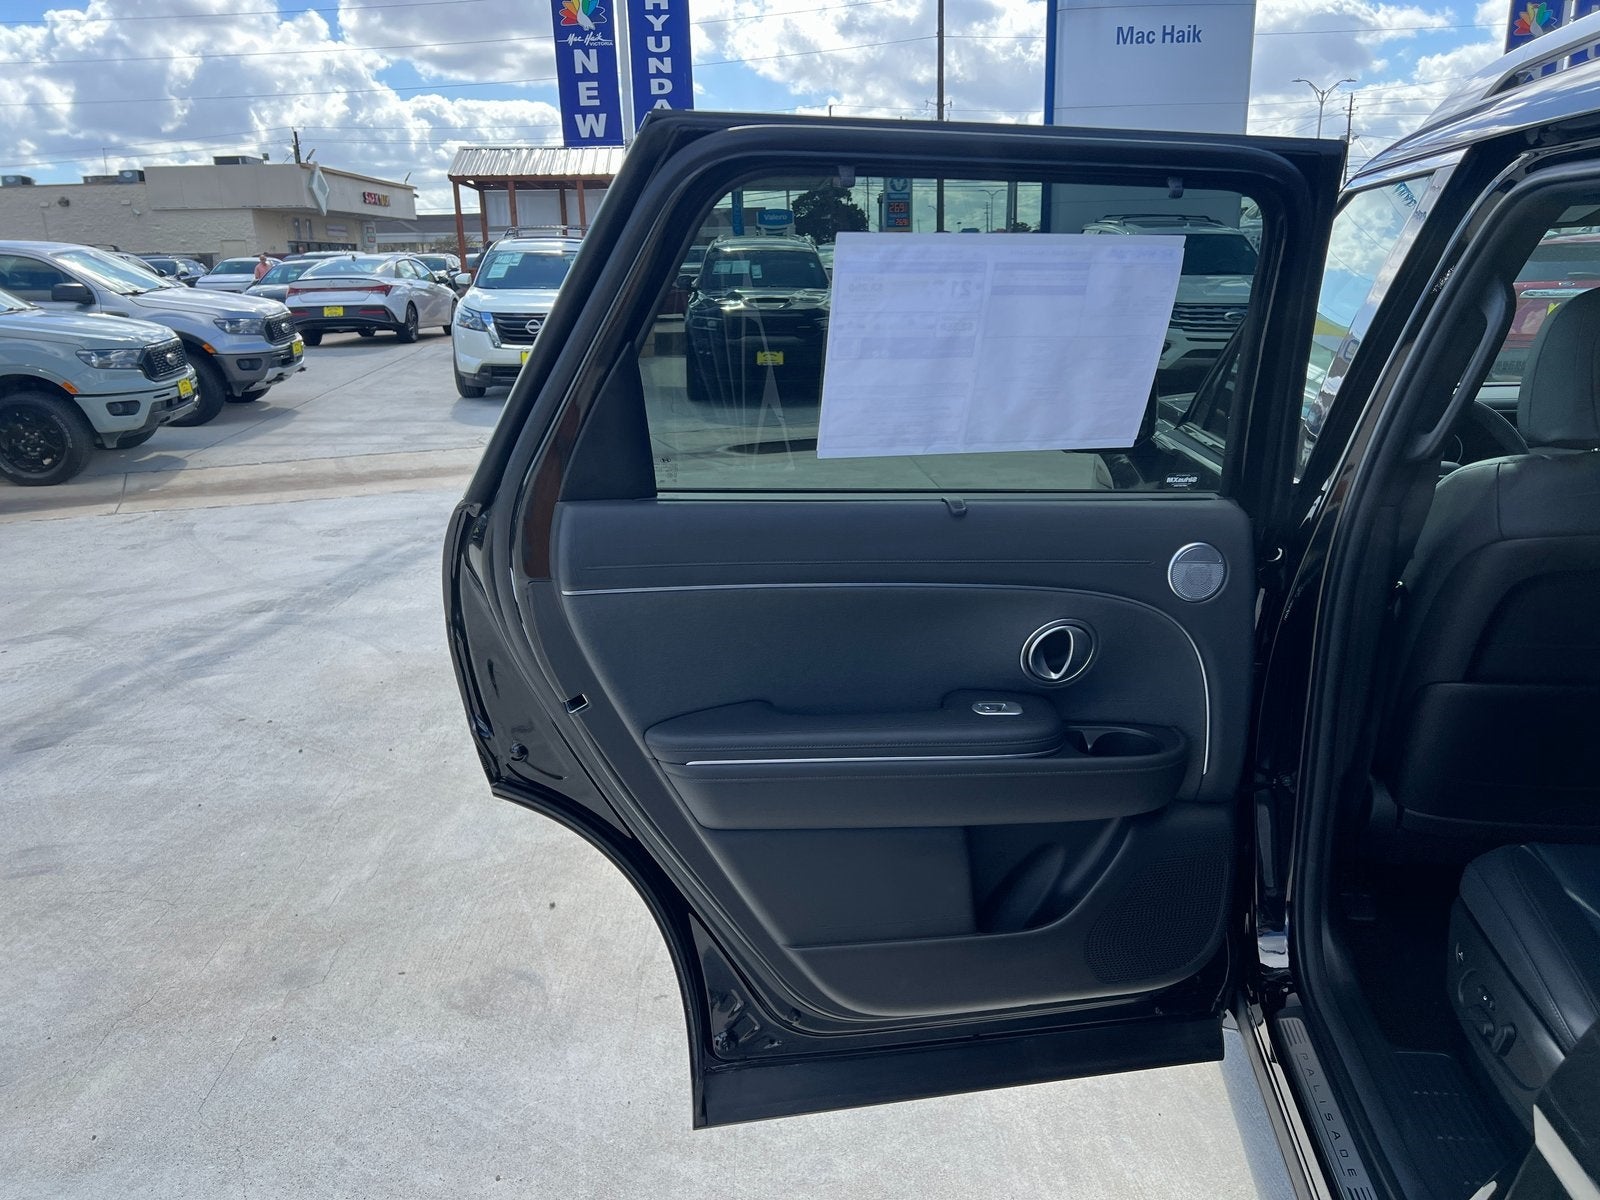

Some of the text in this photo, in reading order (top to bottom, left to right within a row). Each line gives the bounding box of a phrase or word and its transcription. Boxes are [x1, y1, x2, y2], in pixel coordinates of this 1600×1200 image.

[1116, 24, 1202, 45] Mac Haik
[573, 49, 607, 138] NEW
[1301, 1052, 1358, 1178] PALISADE
